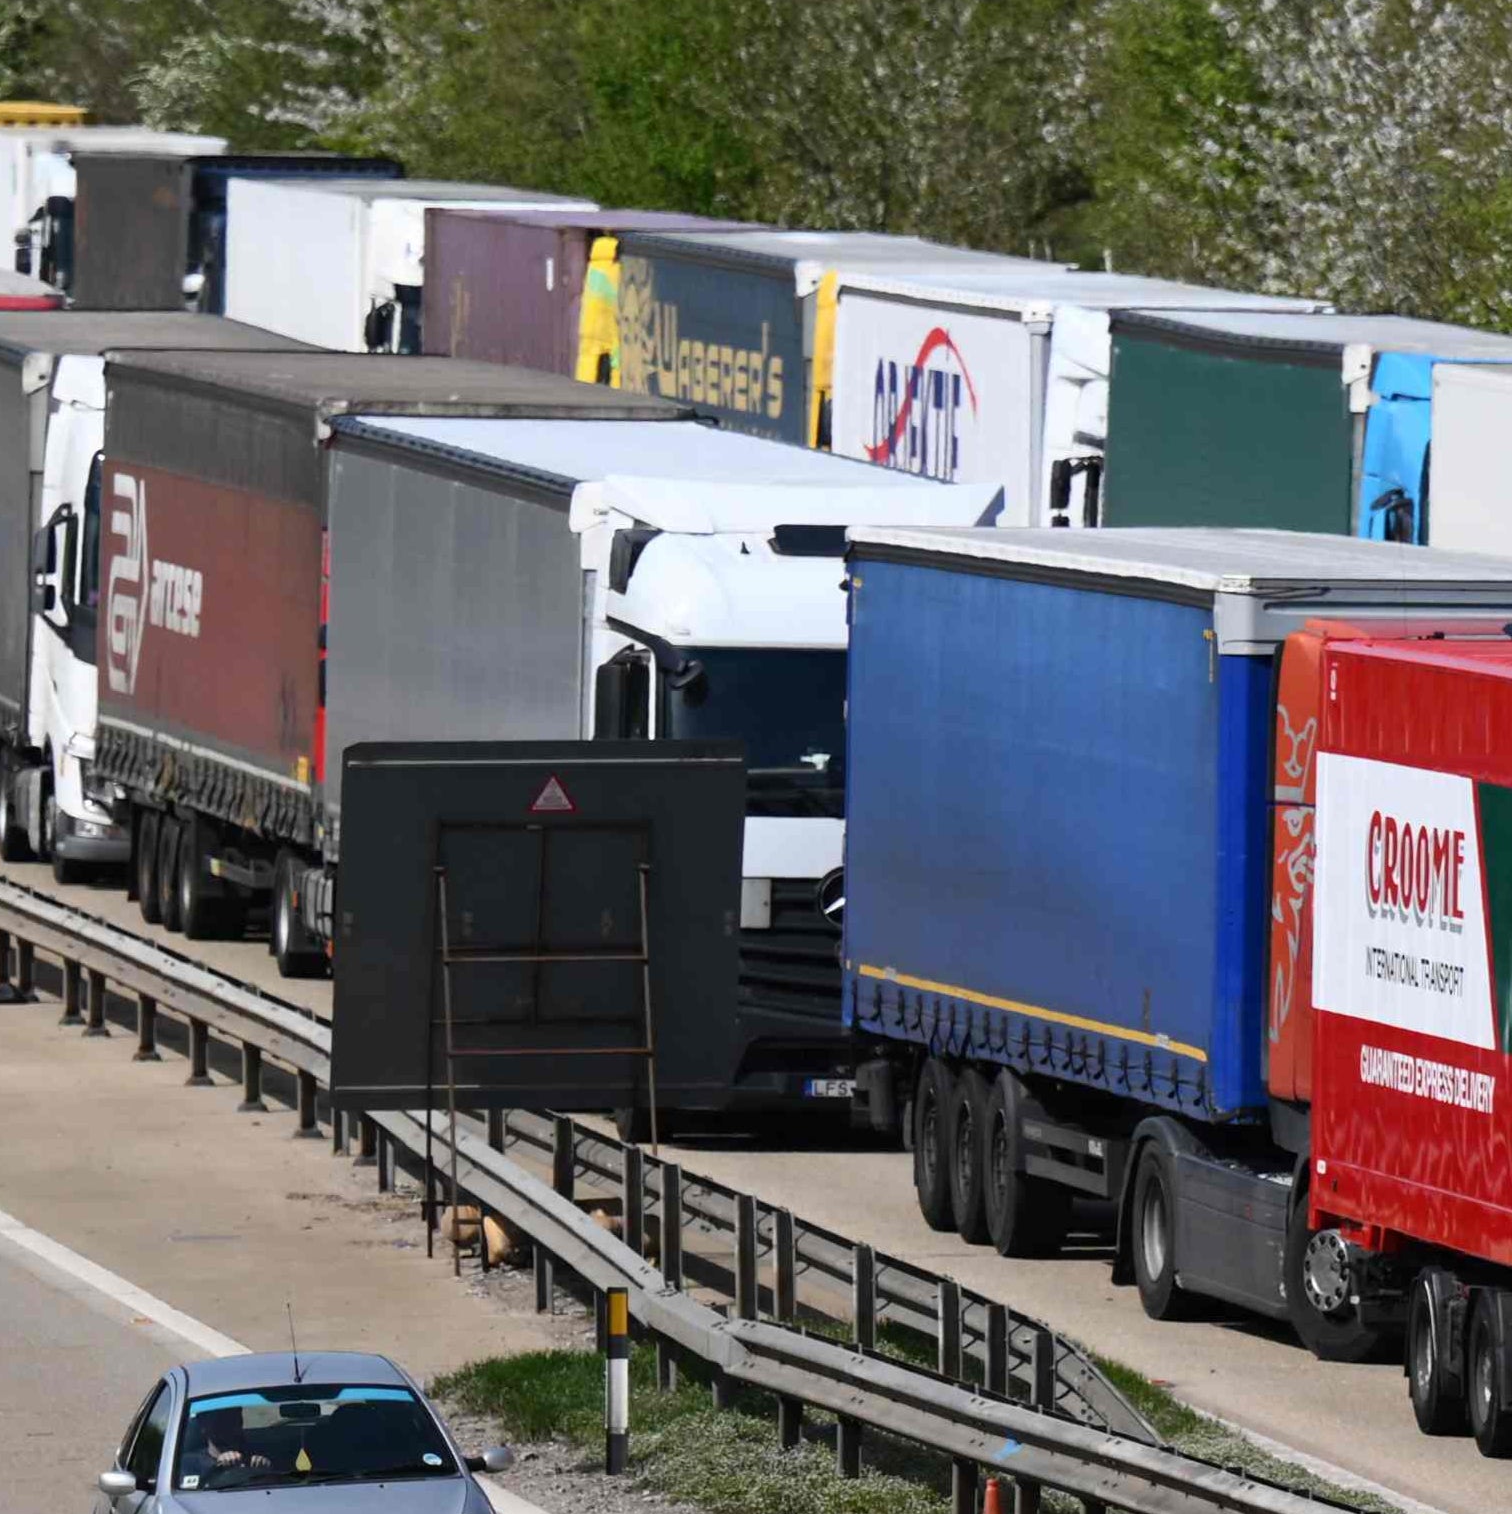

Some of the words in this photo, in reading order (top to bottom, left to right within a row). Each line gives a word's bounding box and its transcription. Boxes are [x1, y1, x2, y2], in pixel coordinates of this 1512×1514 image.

[1367, 810, 1465, 930] CROOME
[1365, 945, 1419, 988] INTERNATIONAL
[1421, 958, 1464, 998] TRANSPORT
[1360, 1044, 1415, 1095] GUARANTEED
[1415, 1057, 1454, 1106] EXPRESS
[1453, 1066, 1496, 1114] DELIVERY
